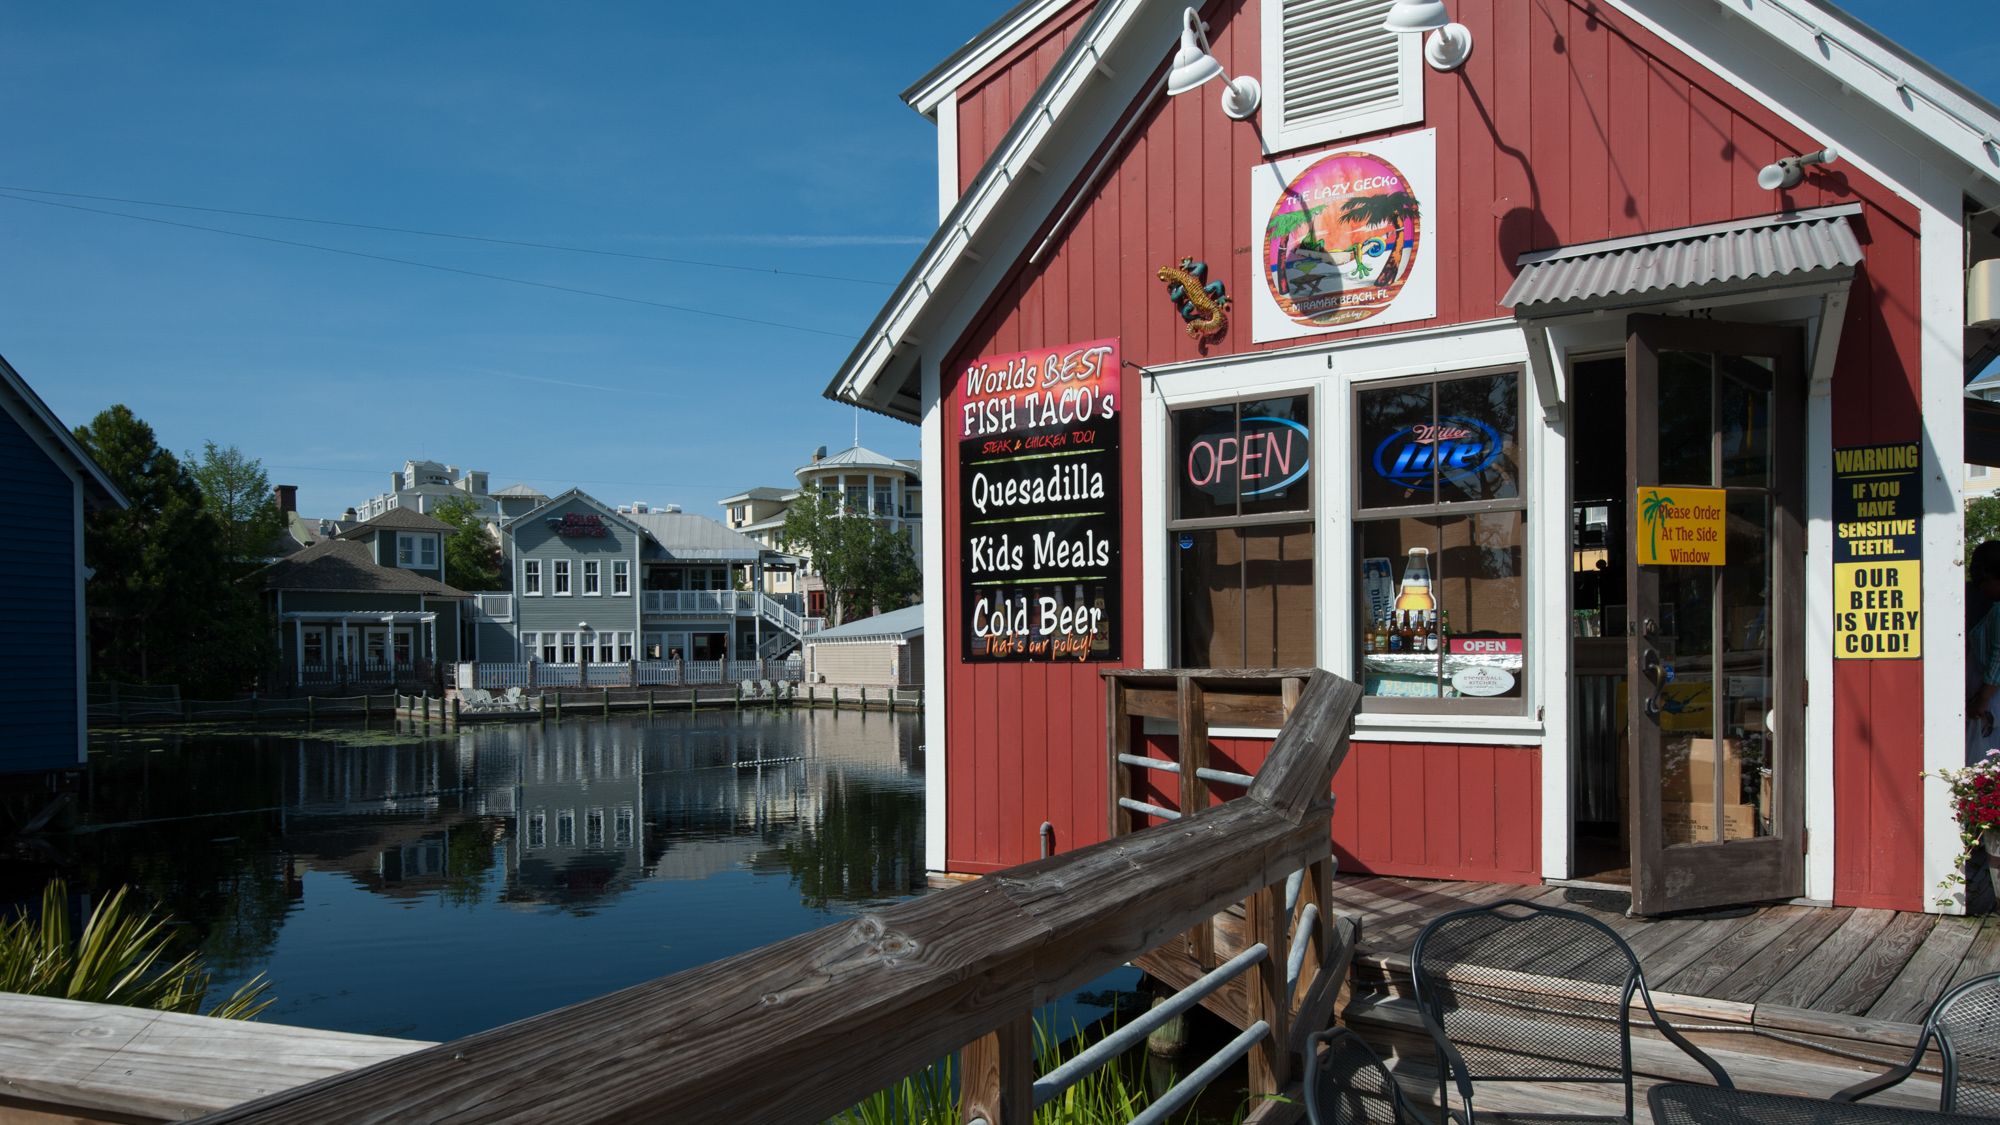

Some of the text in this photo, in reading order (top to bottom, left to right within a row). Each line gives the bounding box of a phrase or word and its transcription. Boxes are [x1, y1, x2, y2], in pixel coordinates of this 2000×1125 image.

[1286, 190, 1310, 206] THE
[1314, 181, 1350, 200] LAZY
[1292, 296, 1338, 313] MIRAMAR
[1377, 289, 1389, 299] FL
[966, 346, 1113, 397] Worlds BEST
[963, 385, 1114, 436] FISH TACO's
[982, 430, 1096, 454] STEAK & CHICKEN TOO!
[1412, 424, 1472, 441] Miller
[1188, 429, 1293, 486] OPEN
[1390, 441, 1484, 474] Lite
[1835, 445, 1919, 473] WARNING
[971, 462, 1105, 514] Quesadilla
[1852, 480, 1900, 499] IF YOU
[1659, 504, 1720, 520] Please Order
[1857, 500, 1896, 518] HAVE
[1661, 526, 1718, 541] At The Side
[1838, 518, 1916, 539] SENSITIVE
[970, 529, 1110, 573] Kids Meals
[1670, 548, 1710, 563] Window
[1849, 539, 1905, 556] TEETH...
[1854, 567, 1898, 588] OUR
[1850, 589, 1904, 610] BEER
[973, 596, 1102, 637] Cold Beer
[1836, 611, 1919, 632] IS VERY
[984, 630, 1094, 663] That's our policy!
[1463, 640, 1507, 652] OPEN
[1845, 633, 1909, 654] COLD!
